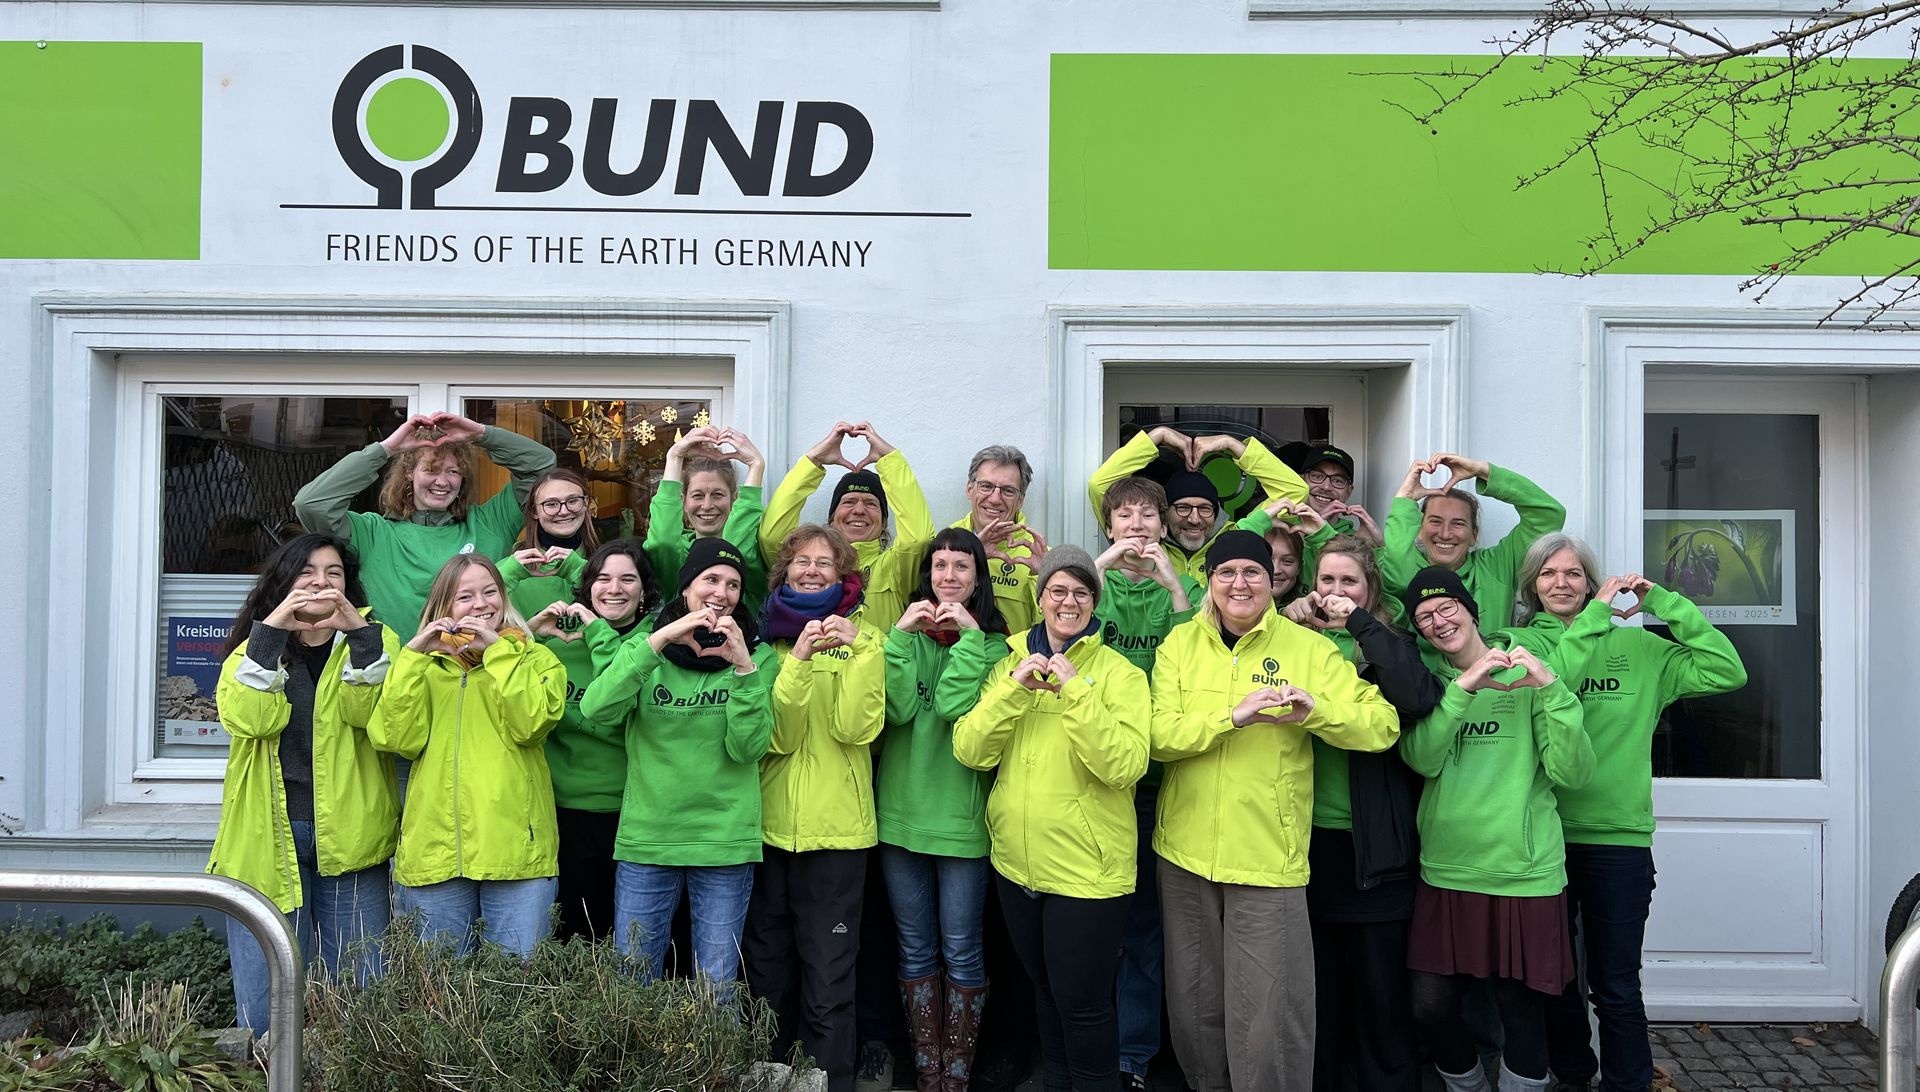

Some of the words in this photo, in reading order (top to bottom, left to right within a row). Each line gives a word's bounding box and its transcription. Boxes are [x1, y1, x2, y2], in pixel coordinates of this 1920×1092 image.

[495, 97, 874, 197] BUND
[326, 234, 458, 262] FRIENDS
[474, 235, 513, 263] OF
[526, 236, 584, 263] THE
[600, 237, 698, 265] EARTH
[715, 238, 873, 268] GERMANY
[991, 575, 1019, 587] BUND
[1703, 610, 1737, 618] IESEN
[1744, 610, 1768, 618] 2025
[176, 624, 236, 638] Kreislauf
[1117, 633, 1159, 649] BUND
[1252, 674, 1289, 687] BUND
[1578, 677, 1620, 693] UND
[673, 688, 730, 707] BUND
[1460, 720, 1500, 736] UND
